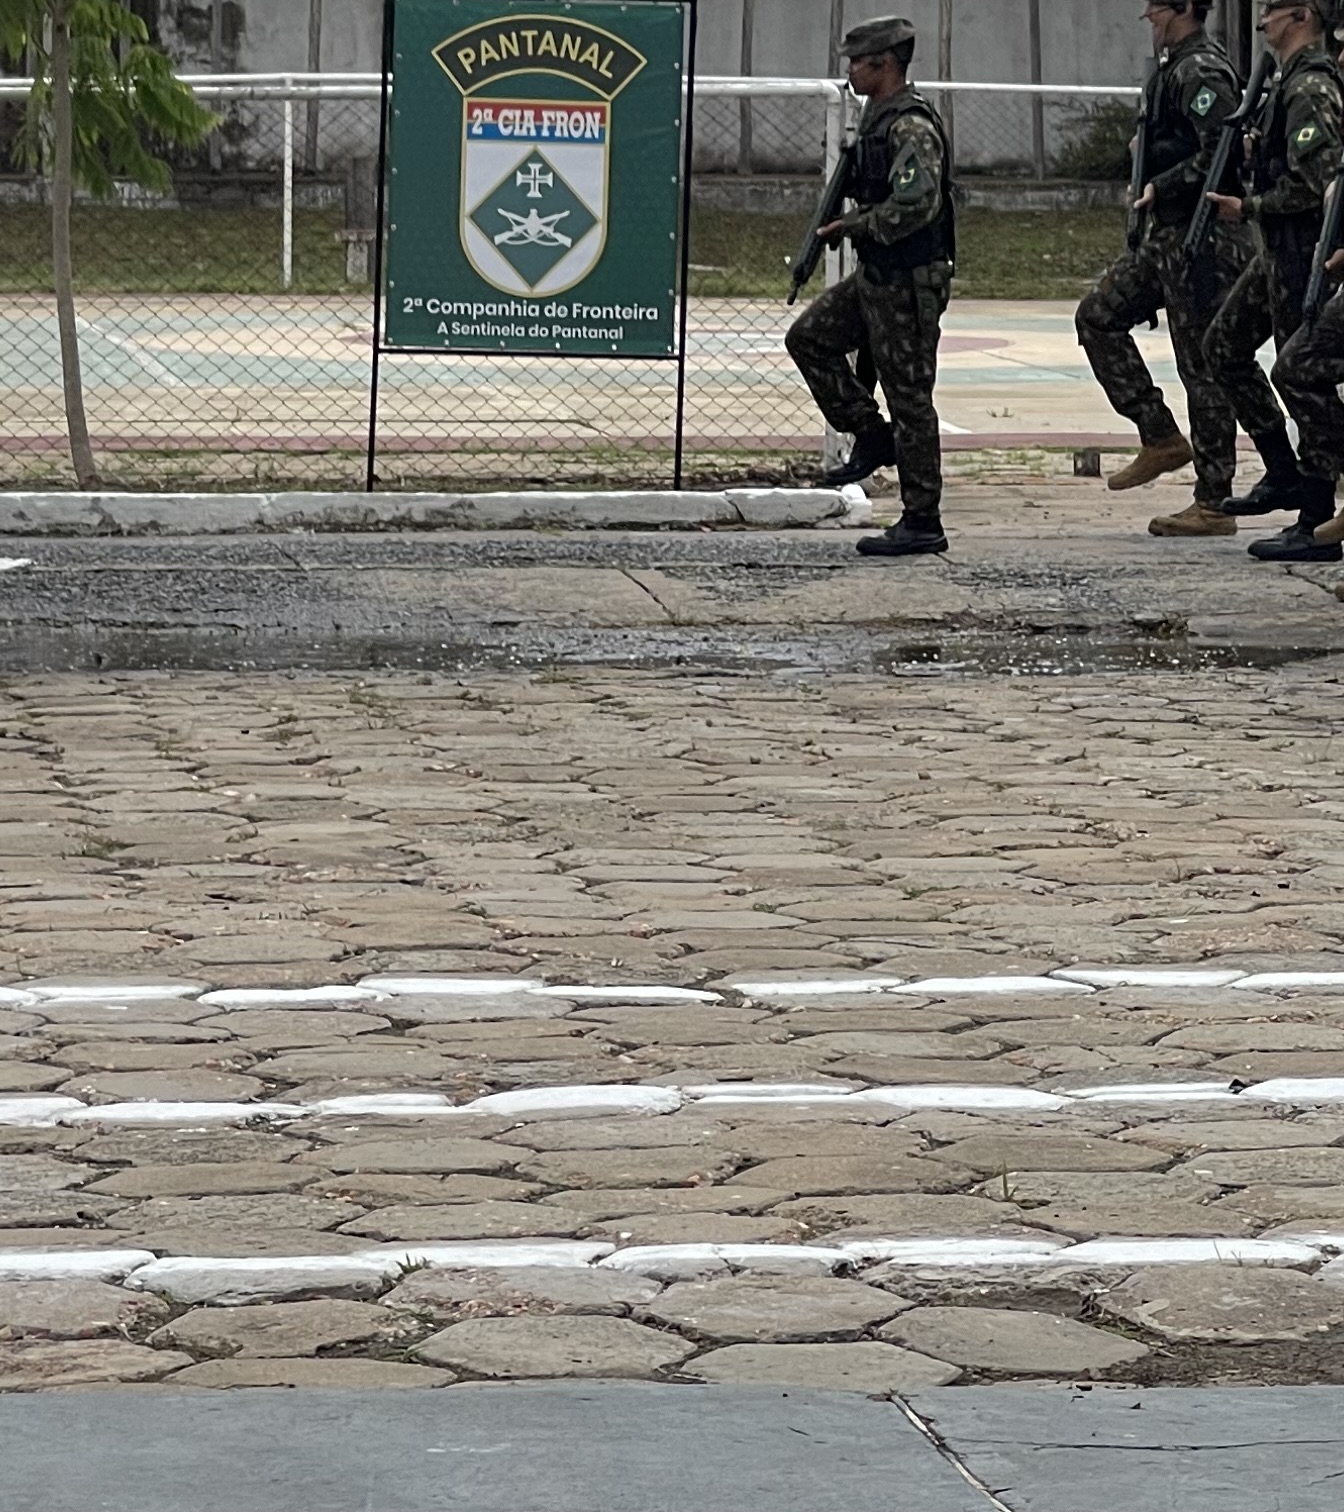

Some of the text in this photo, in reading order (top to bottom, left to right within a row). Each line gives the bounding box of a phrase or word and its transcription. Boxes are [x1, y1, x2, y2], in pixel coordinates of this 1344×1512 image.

[457, 30, 615, 79] PANTANAL
[497, 108, 537, 137] CIA
[541, 110, 601, 139] FRON
[426, 298, 540, 320] Companhia
[544, 301, 569, 318] de
[572, 302, 659, 320] Fronteira
[437, 321, 624, 340] A Sentinela do Pantanal
